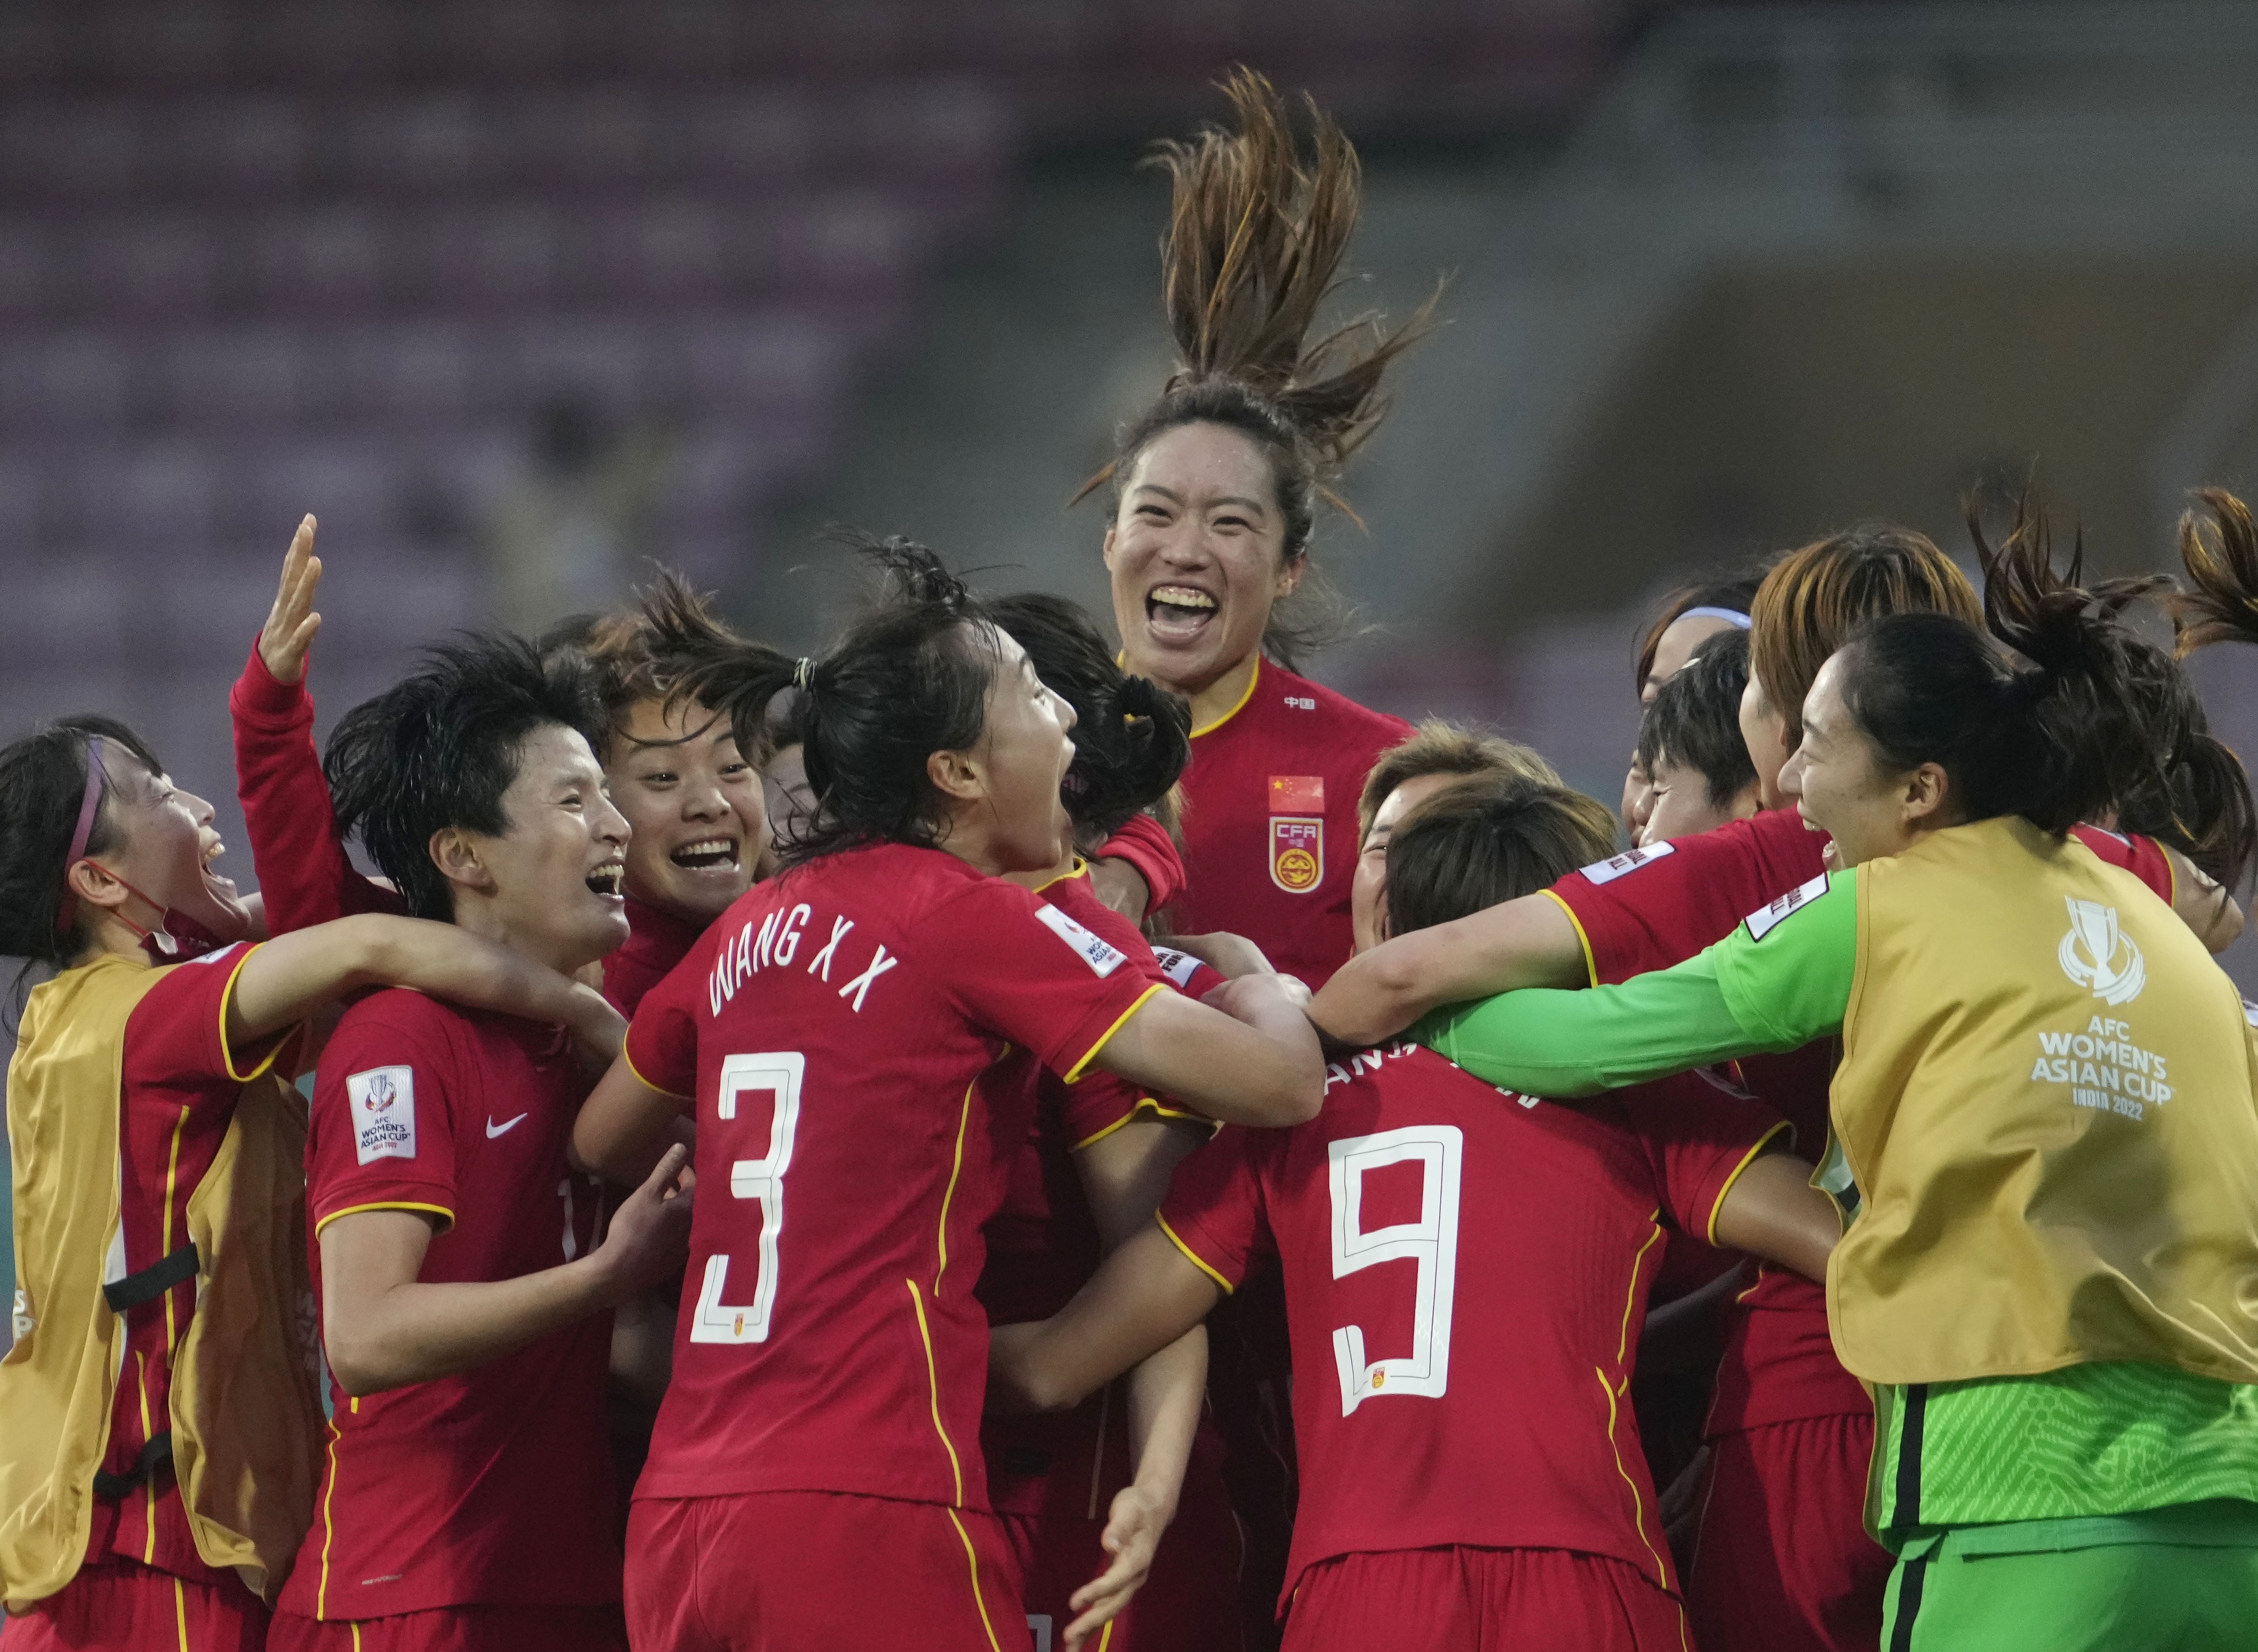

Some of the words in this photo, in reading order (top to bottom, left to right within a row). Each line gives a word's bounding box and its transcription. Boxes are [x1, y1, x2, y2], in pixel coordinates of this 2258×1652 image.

[1284, 696, 1315, 710] 中国
[1276, 824, 1316, 838] CFA
[708, 903, 811, 1018] WANG
[807, 914, 855, 982] X
[839, 944, 898, 1013] X
[2088, 1015, 2130, 1041] AFC
[2038, 1032, 2167, 1080] WOMEN'S
[2031, 1057, 2120, 1091] ASIAN
[375, 1116, 389, 1125] AFC
[2112, 1095, 2144, 1121] 2022
[361, 1133, 386, 1148] ASIAN
[362, 1124, 405, 1138] WOMEN'S
[690, 1051, 804, 1343] 3
[1328, 1125, 1463, 1418] 9
